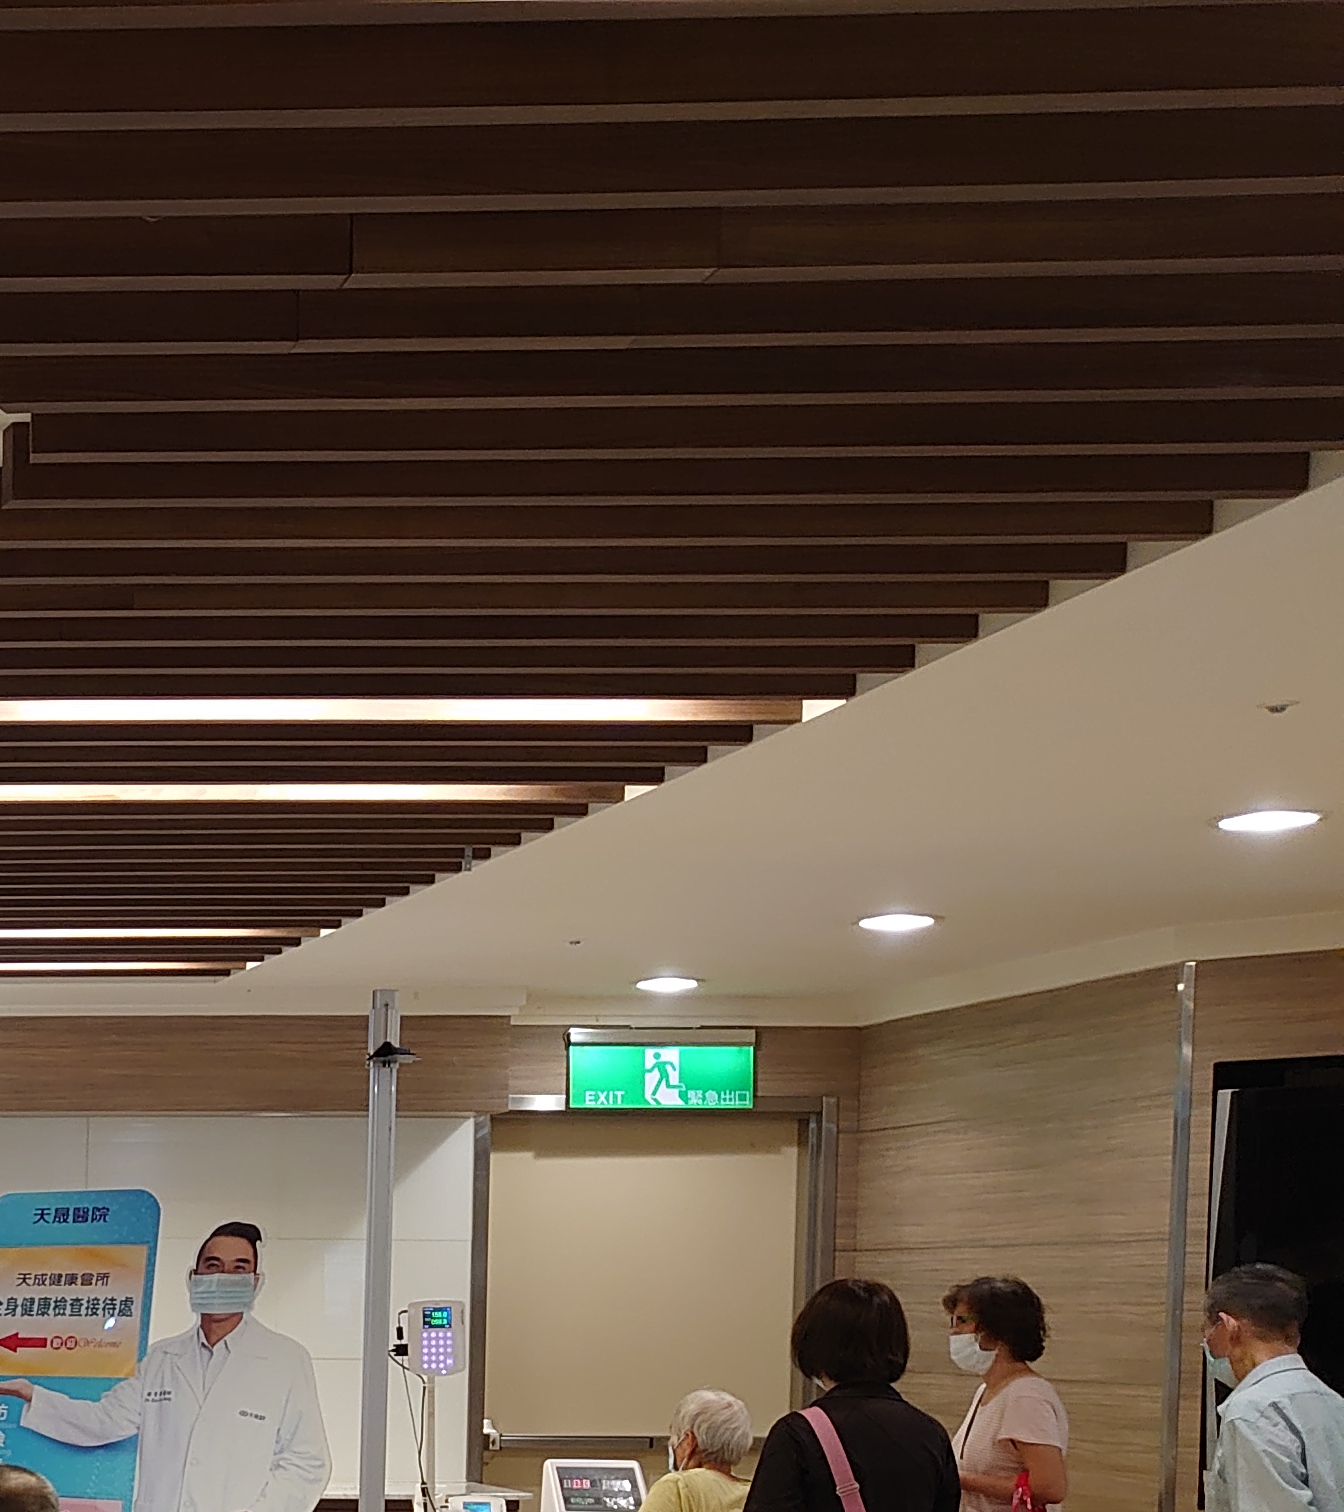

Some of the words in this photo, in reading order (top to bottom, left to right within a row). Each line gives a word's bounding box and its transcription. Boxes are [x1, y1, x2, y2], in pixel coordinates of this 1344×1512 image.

[584, 1090, 625, 1105] EXIT
[687, 1089, 749, 1106] 緊急出口
[32, 1206, 111, 1225] 天晟醫院
[15, 1272, 111, 1287] 天成健康會所
